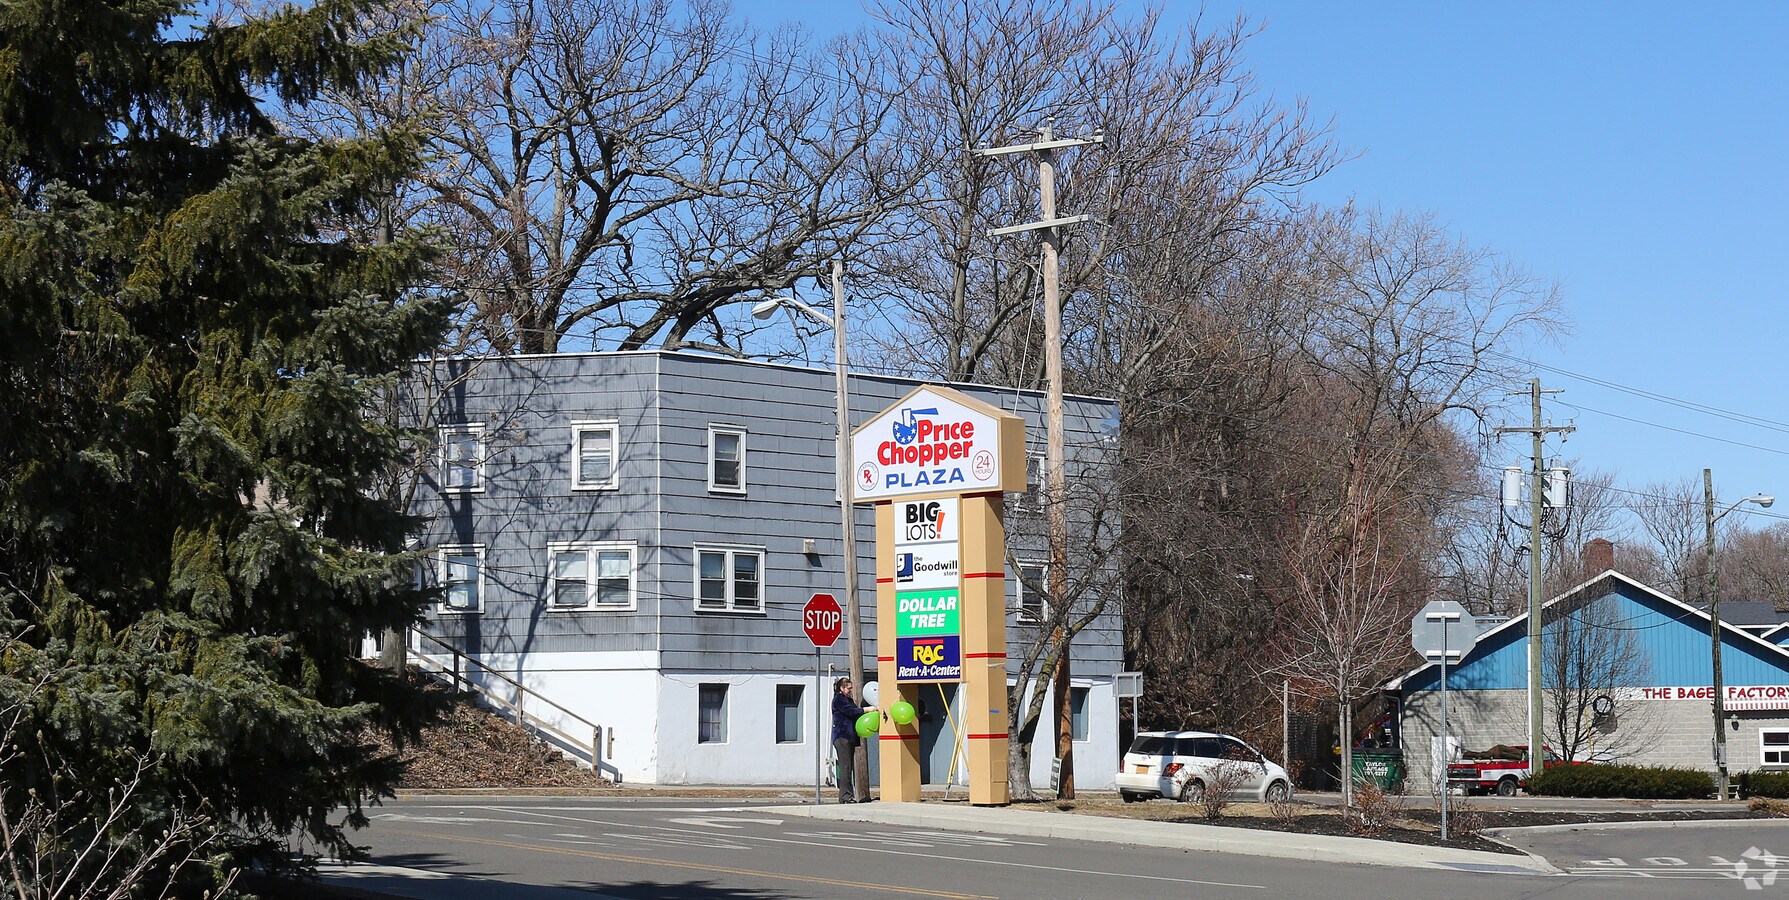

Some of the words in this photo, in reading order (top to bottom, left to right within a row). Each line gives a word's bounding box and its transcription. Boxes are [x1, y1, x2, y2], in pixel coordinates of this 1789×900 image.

[918, 419, 974, 443] Price
[877, 441, 973, 467] Chopper
[977, 455, 990, 468] 24
[885, 468, 965, 489] PLAZA
[906, 502, 940, 524] BIG
[914, 560, 958, 572] Goodwill
[898, 596, 957, 613] DOLLAR
[806, 610, 840, 630] STOP
[909, 613, 946, 629] TREE
[913, 644, 944, 666] RAC
[1643, 687, 1671, 699] THE
[1678, 687, 1715, 699] BAGE
